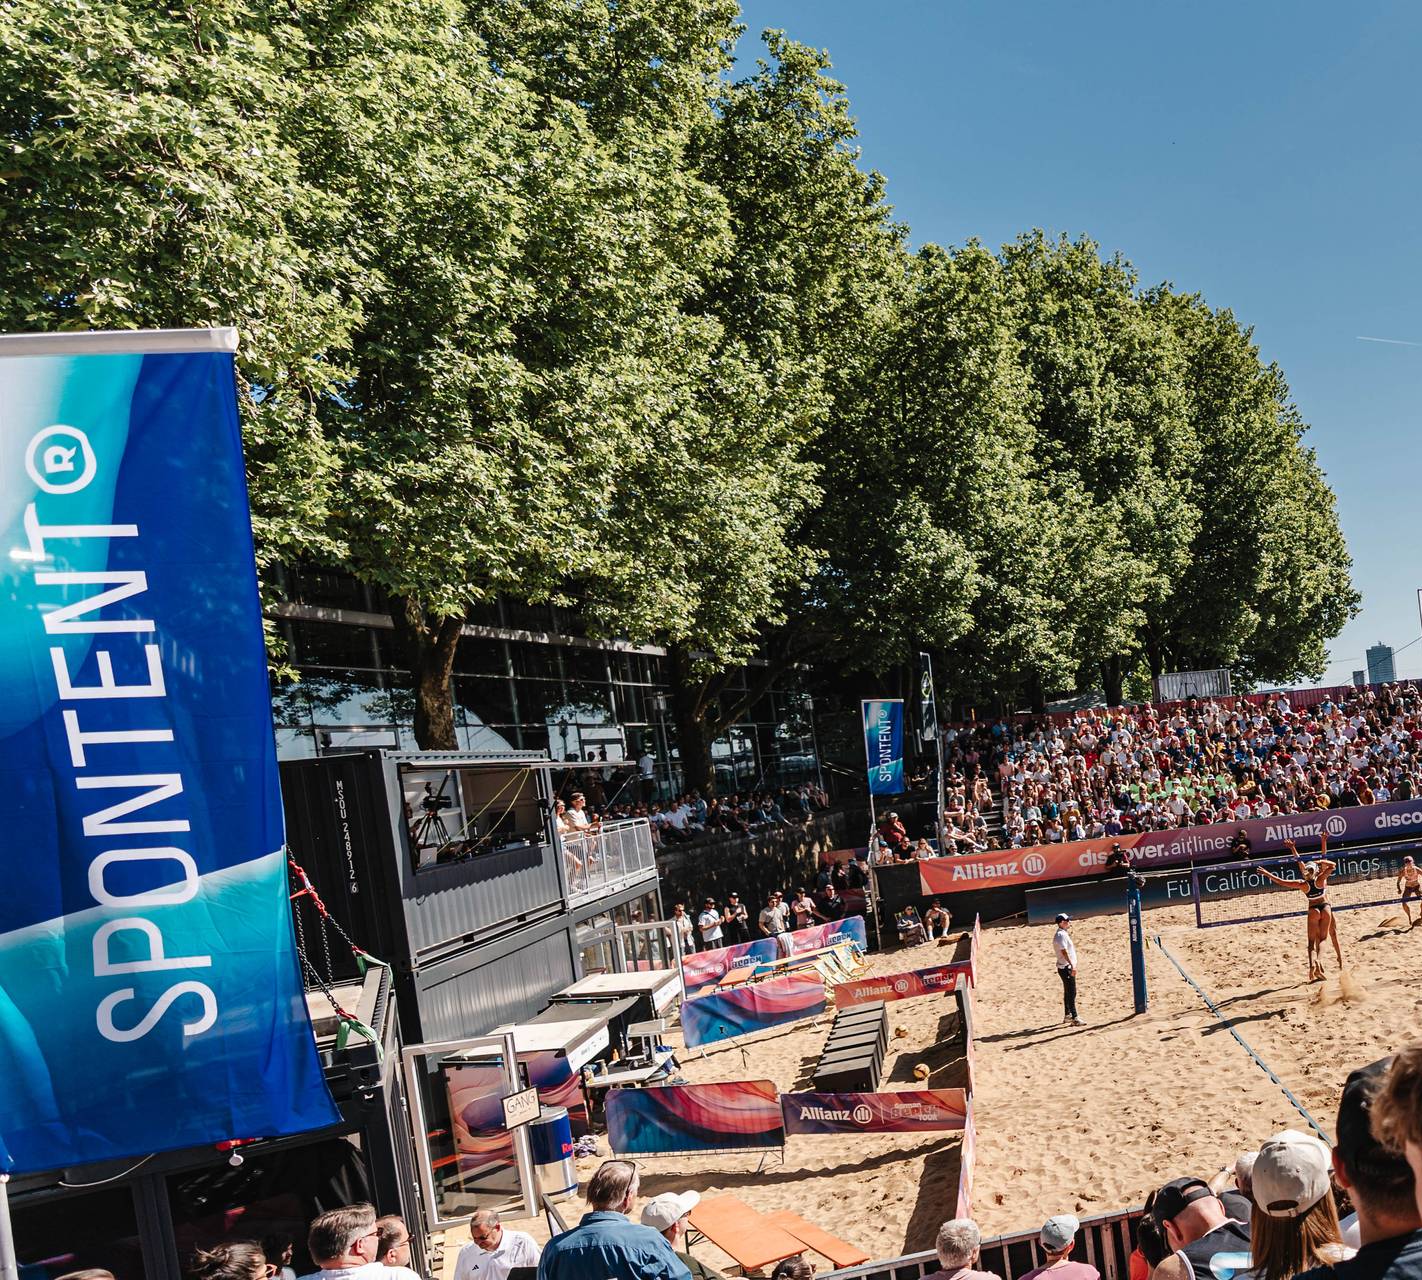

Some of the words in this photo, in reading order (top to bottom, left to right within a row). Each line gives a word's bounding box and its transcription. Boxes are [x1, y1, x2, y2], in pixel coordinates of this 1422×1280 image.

[336, 780, 347, 819] MSOU
[342, 822, 355, 879] 248912
[1265, 822, 1323, 842] Allianz
[952, 861, 1019, 881] Allianz
[1167, 879, 1191, 899] Fü
[854, 984, 893, 999] Allianz
[506, 1090, 536, 1114] GANG
[800, 1106, 851, 1121] Allianz
